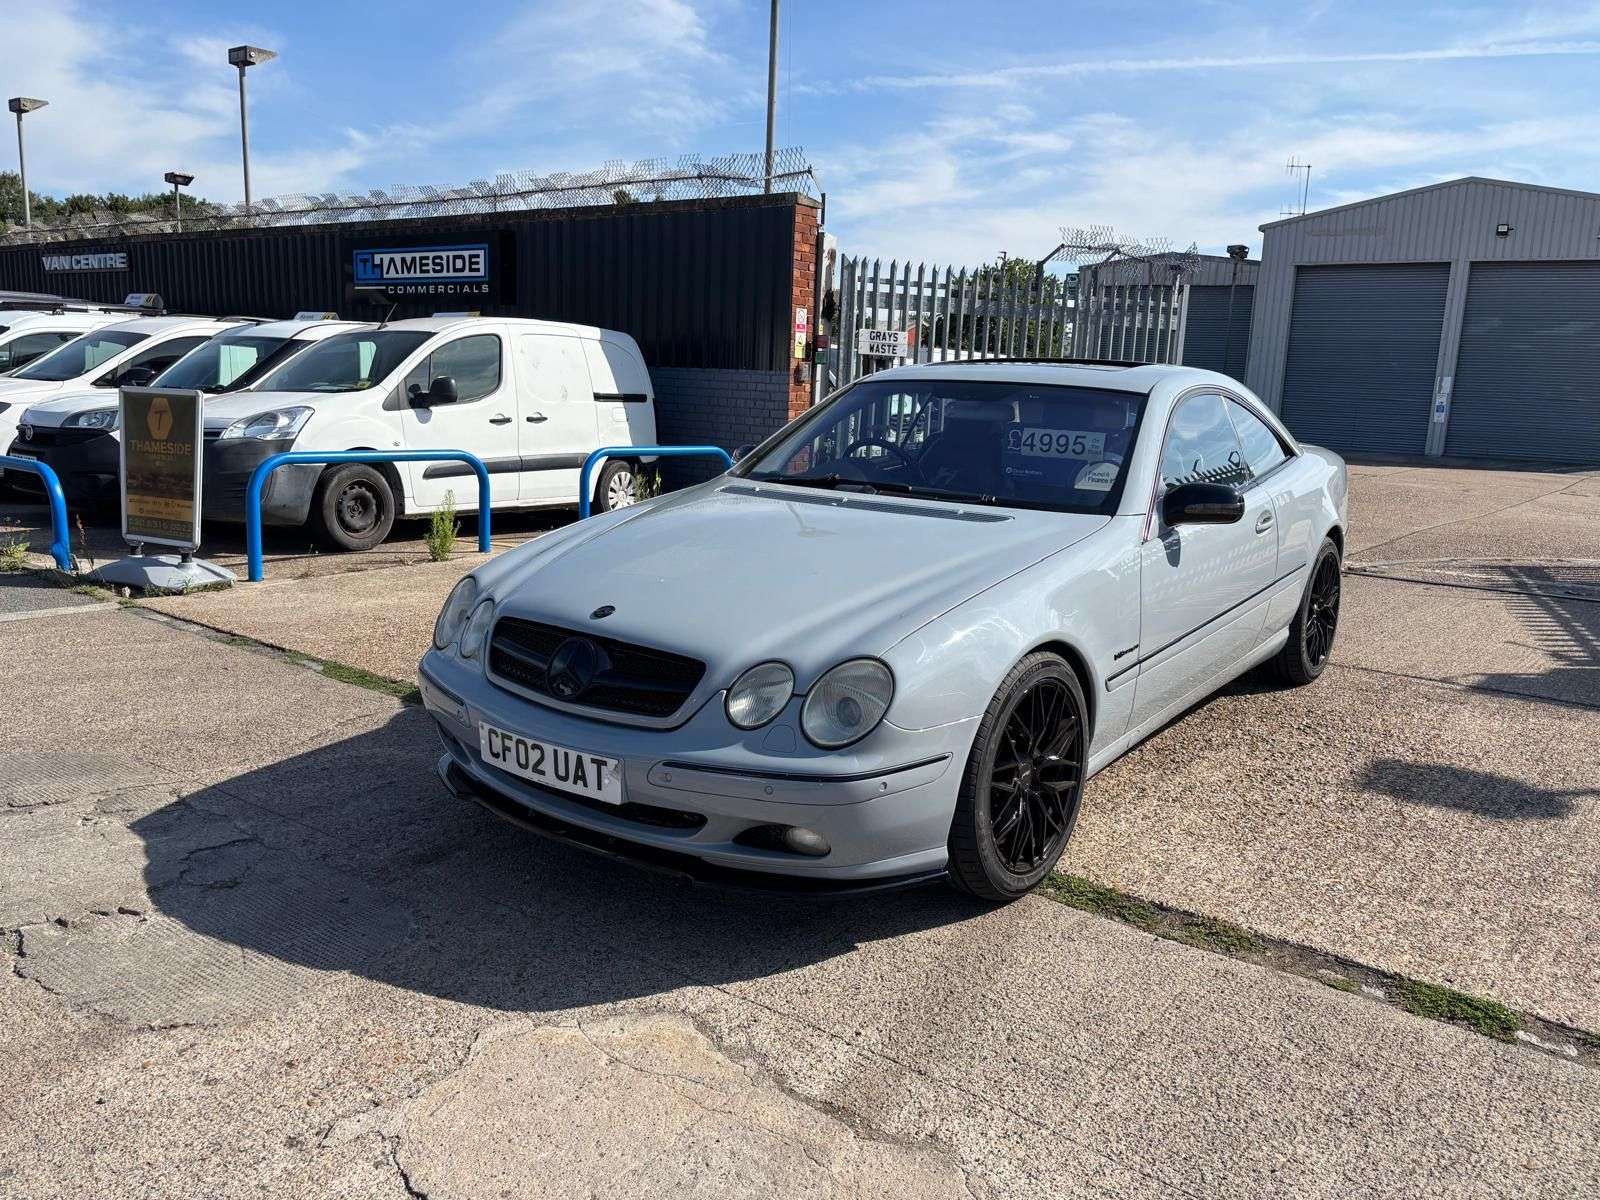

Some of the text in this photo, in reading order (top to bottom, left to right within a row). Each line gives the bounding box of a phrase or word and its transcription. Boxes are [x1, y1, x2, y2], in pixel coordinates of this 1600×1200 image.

[42, 253, 128, 270] VAN CENTRE
[358, 255, 481, 277] THAMESIDE
[388, 284, 489, 294] COMMERCIALS
[870, 331, 898, 342] GRAYS
[870, 343, 897, 355] WASTE
[130, 440, 192, 456] THAMESIDE
[488, 727, 607, 791] CF02 UAT
